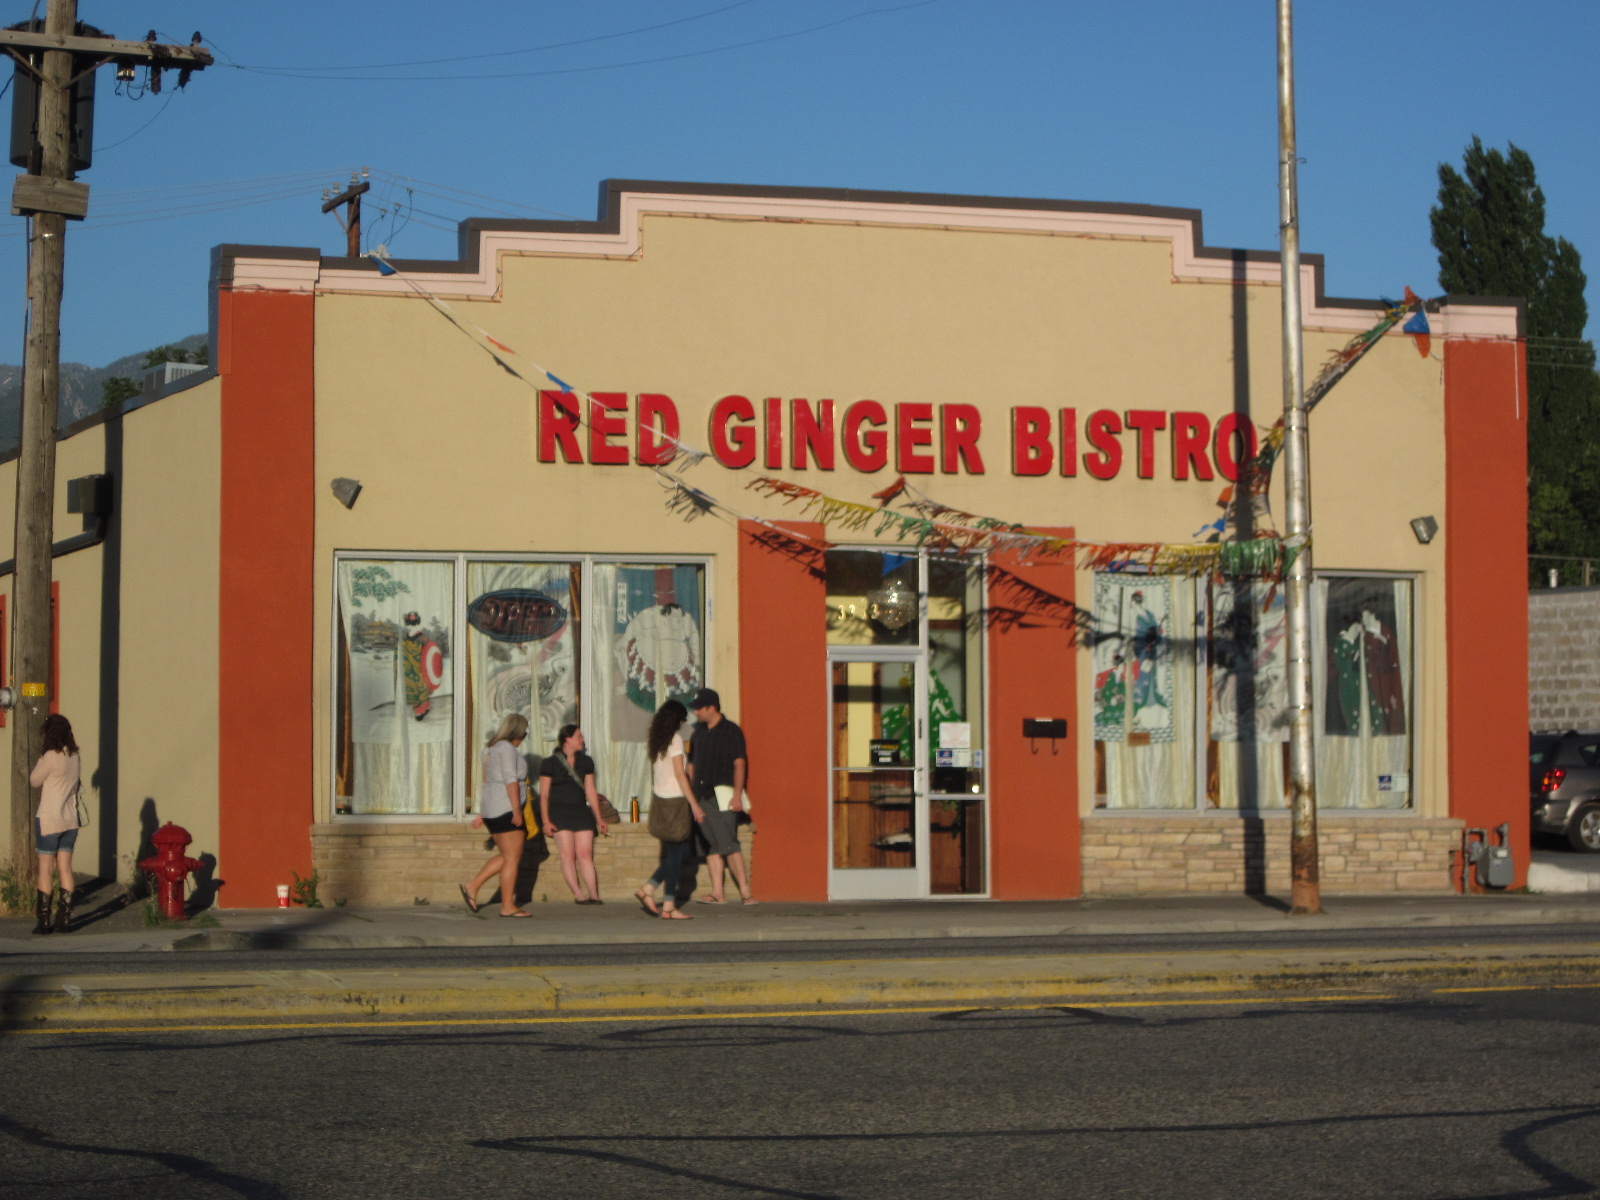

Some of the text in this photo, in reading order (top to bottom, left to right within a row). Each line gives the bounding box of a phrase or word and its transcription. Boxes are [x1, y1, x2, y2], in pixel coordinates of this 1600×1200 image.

[538, 390, 1258, 482] RED GINGER BISTRO
[480, 598, 558, 634] OPEN
